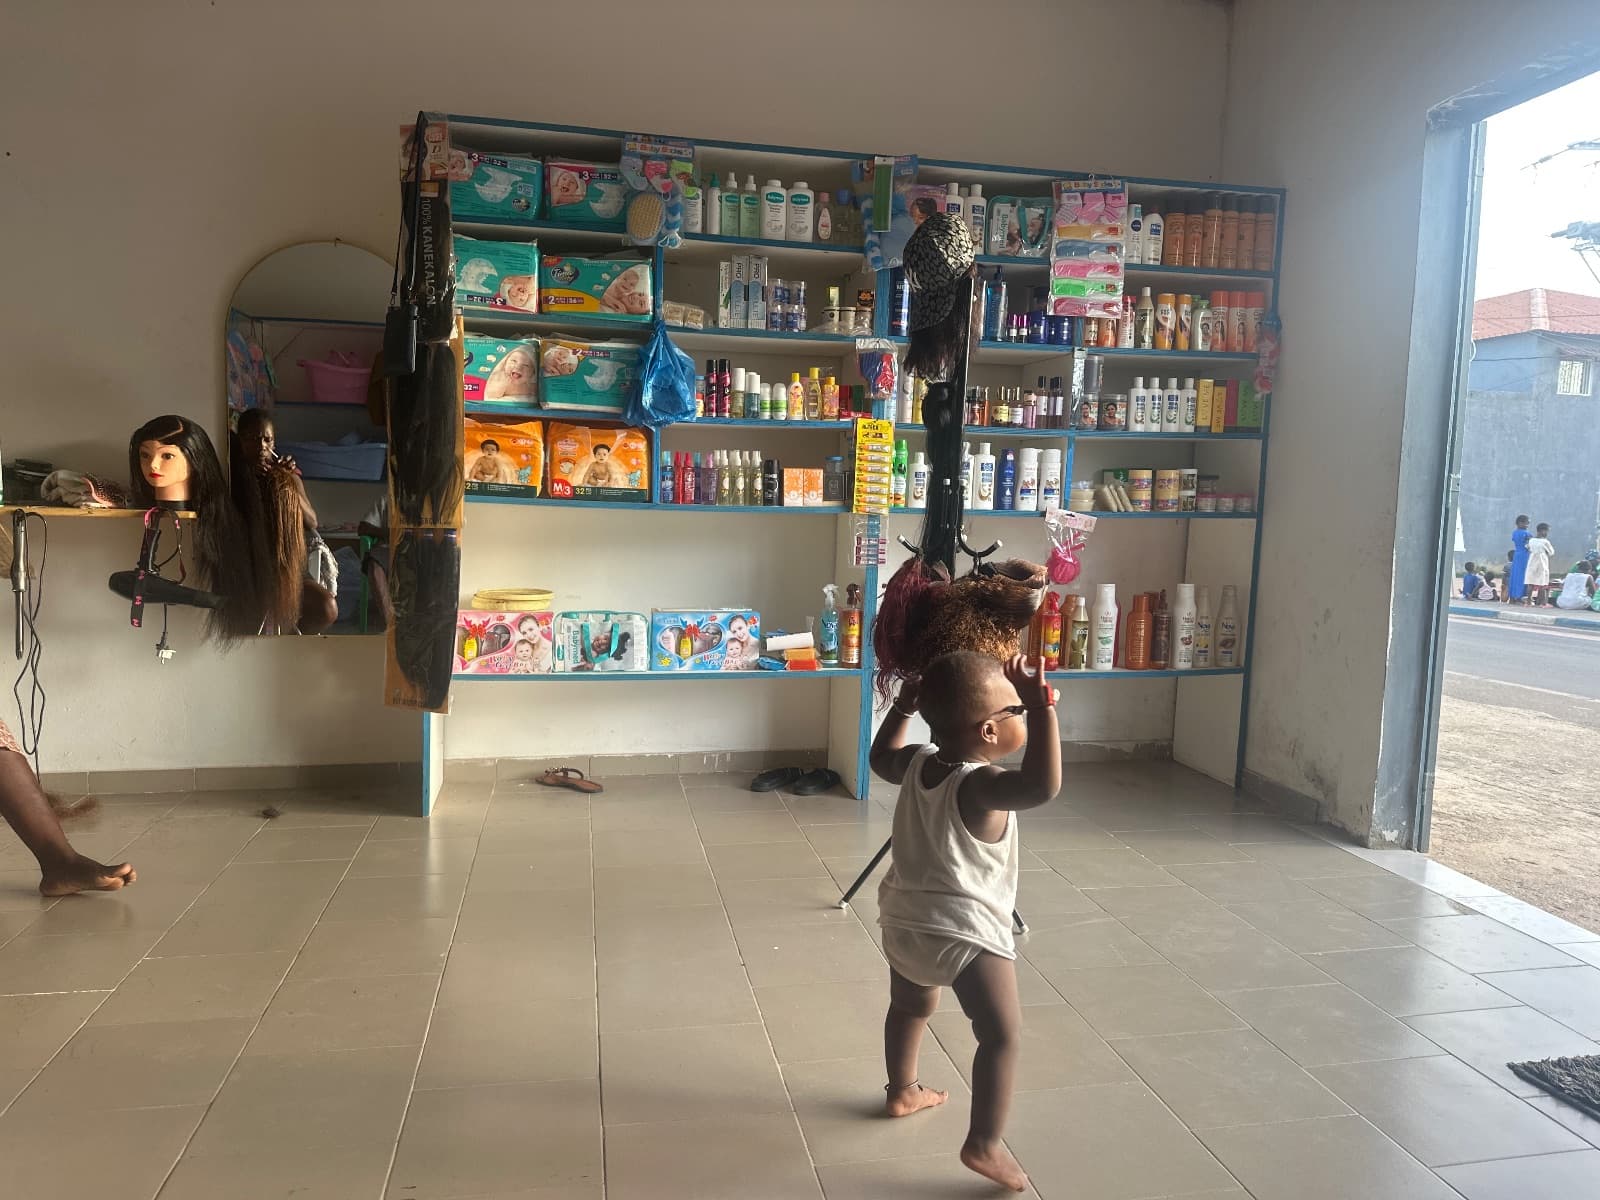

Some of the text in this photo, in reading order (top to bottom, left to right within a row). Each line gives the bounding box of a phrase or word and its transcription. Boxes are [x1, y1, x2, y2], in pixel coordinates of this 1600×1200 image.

[471, 153, 479, 162] 3
[582, 171, 590, 180] 3
[422, 226, 436, 304] KANEKALON
[495, 297, 503, 306] 3
[548, 296, 556, 305] 2
[576, 348, 583, 357] 2
[575, 487, 585, 495] 32
[571, 630, 580, 664] Babymed
